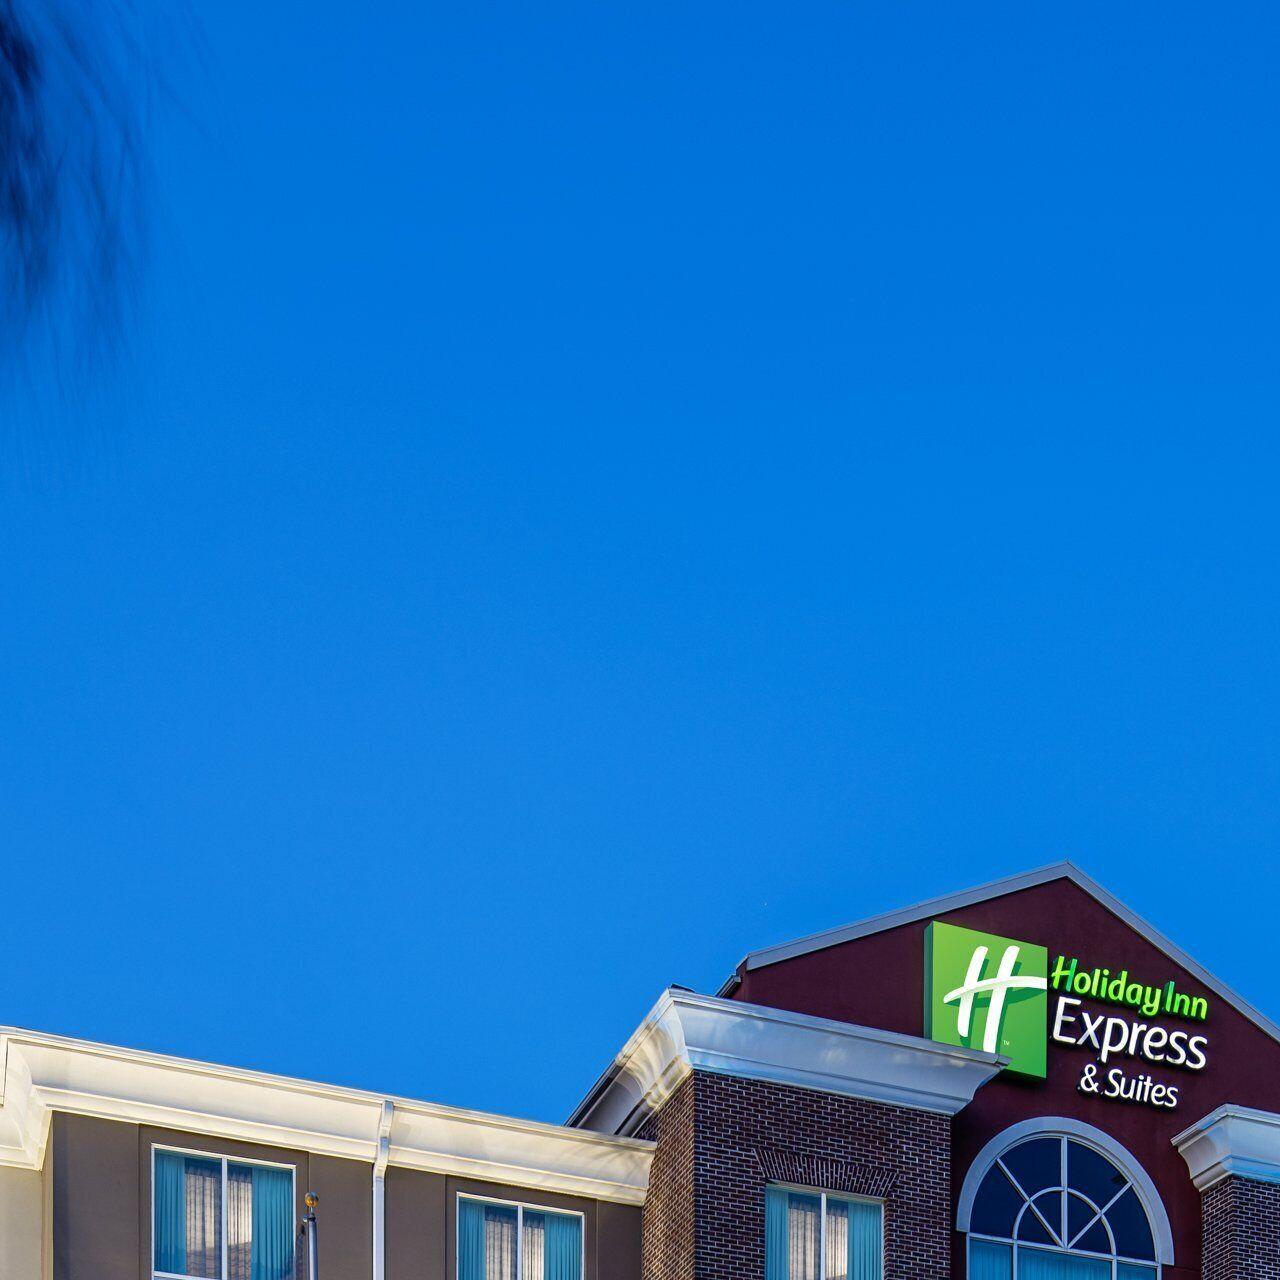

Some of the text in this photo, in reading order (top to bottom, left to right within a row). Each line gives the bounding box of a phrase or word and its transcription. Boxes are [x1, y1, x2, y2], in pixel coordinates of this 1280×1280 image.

[1051, 956, 1208, 1020] Holiday Inn
[1053, 996, 1208, 1070] Express
[1080, 1064, 1179, 1108] & Suites
